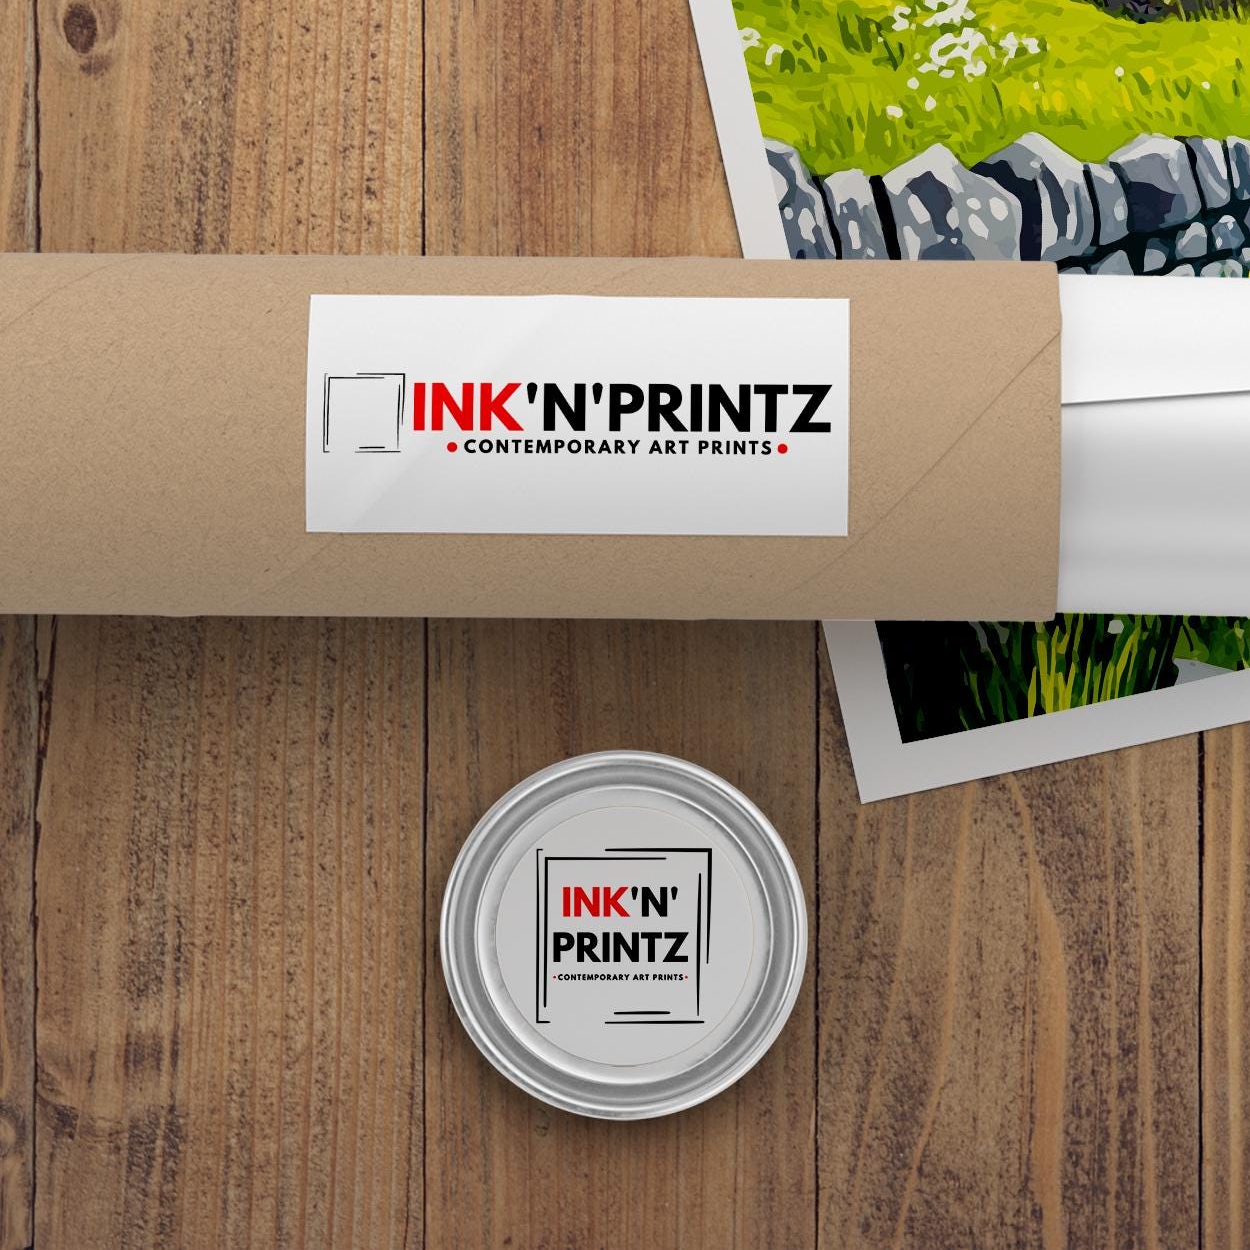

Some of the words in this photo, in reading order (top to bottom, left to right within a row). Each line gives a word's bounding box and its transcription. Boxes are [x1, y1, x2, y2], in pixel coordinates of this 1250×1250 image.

[413, 382, 833, 433] INK'N'PRINTZ
[463, 438, 641, 455] CONTEMPORARY
[648, 439, 690, 455] ART
[698, 440, 772, 456] PRINTS
[562, 885, 679, 918] INK'N'
[552, 931, 689, 963] PRINTZ
[557, 973, 630, 981] CONTEMPORARY
[632, 973, 650, 981] ART
[652, 973, 684, 981] PRINTS
